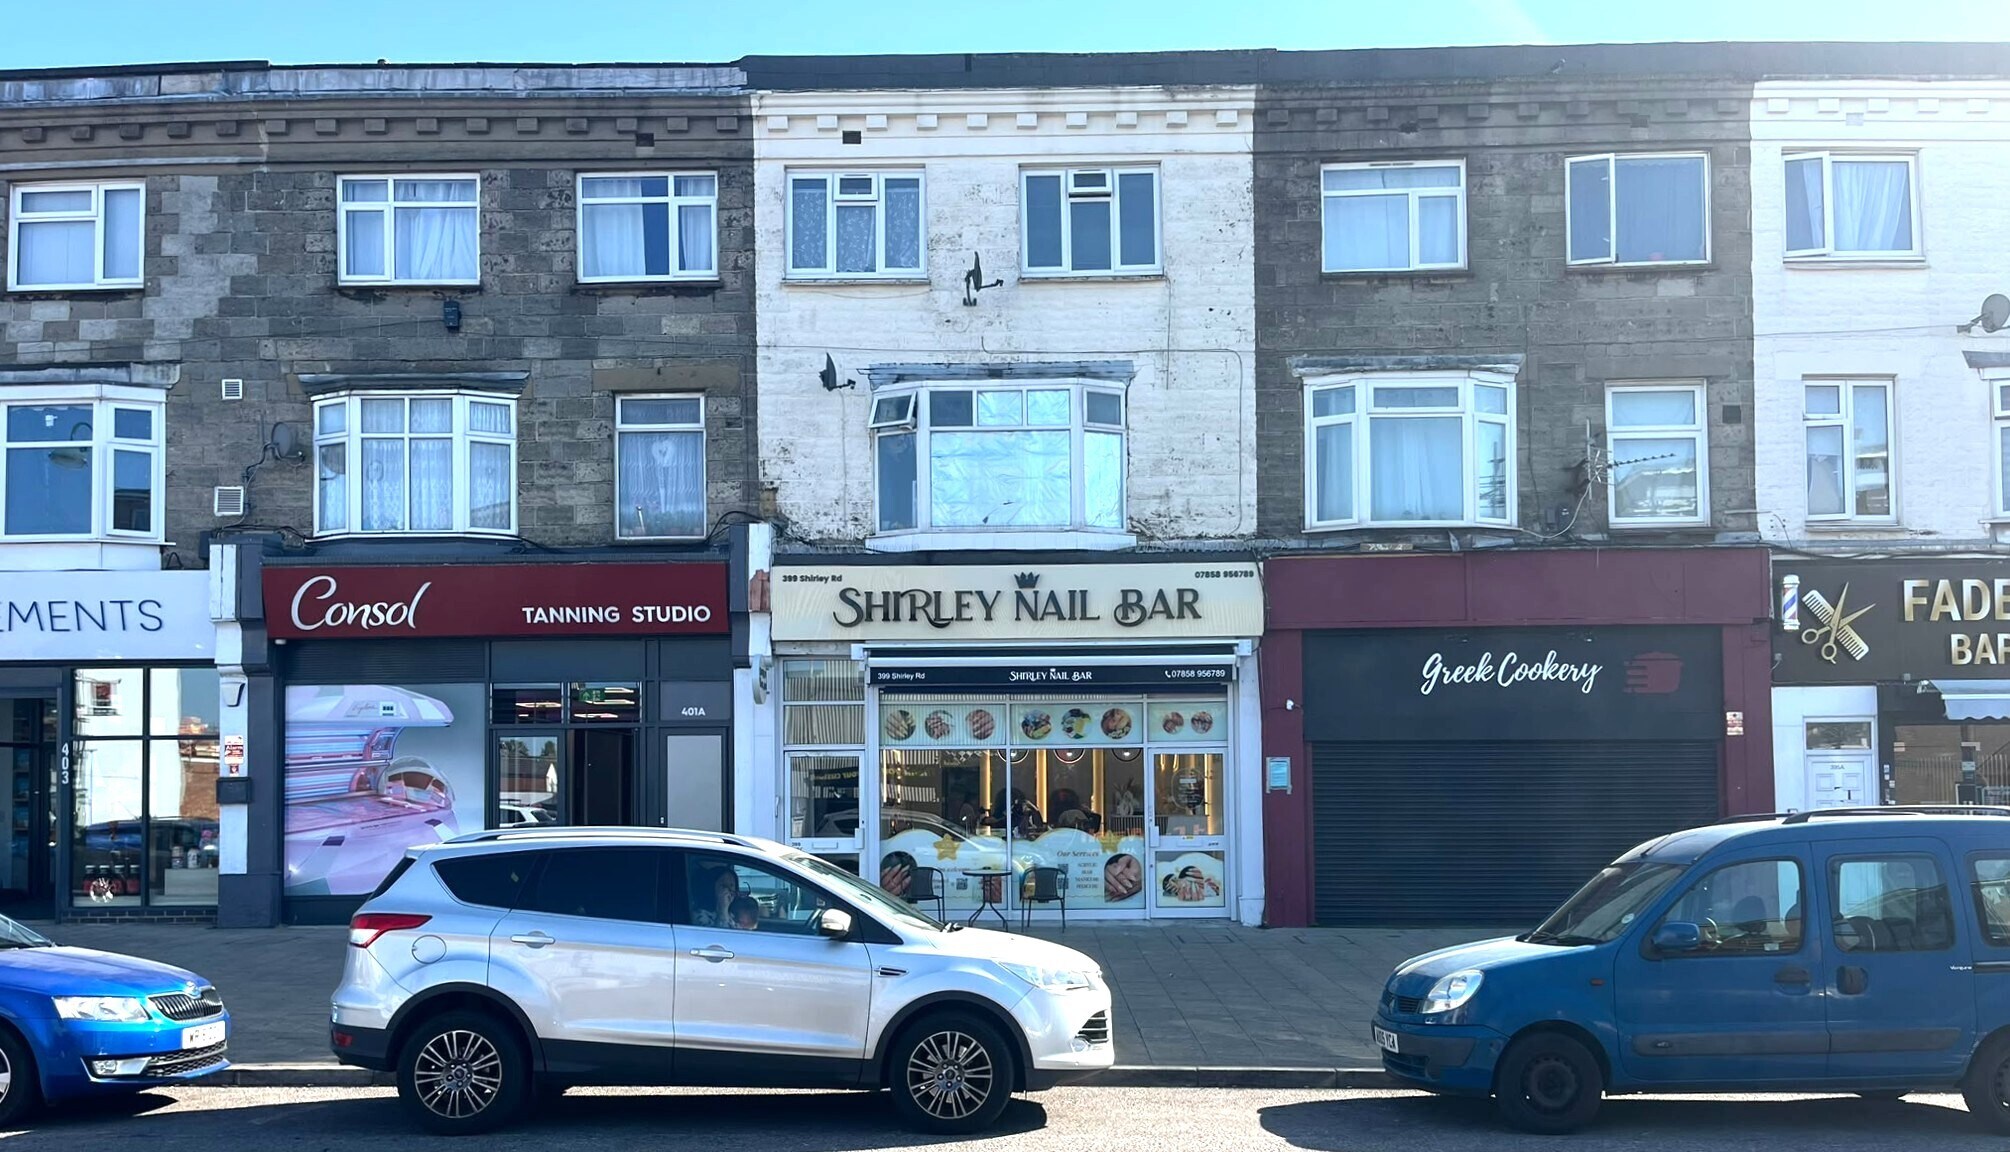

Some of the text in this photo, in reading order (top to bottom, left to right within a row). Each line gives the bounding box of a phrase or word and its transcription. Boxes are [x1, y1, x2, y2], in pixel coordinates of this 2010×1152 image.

[782, 574, 842, 584] 399 Shirley Rd
[1194, 570, 1254, 578] 07858 956789
[291, 575, 431, 630] Consol
[833, 587, 1203, 629] SHIRLEY NAIL BAR
[0, 600, 163, 632] MENTS
[521, 605, 711, 624] TANNING STUDIO
[877, 672, 926, 681] 399 Shirley Rd
[1008, 670, 1093, 682] SHIRLEY NAIL BAR
[1171, 669, 1226, 678] 07858 956789
[1420, 649, 1603, 695] Greek Cookery
[681, 706, 706, 716] 401A
